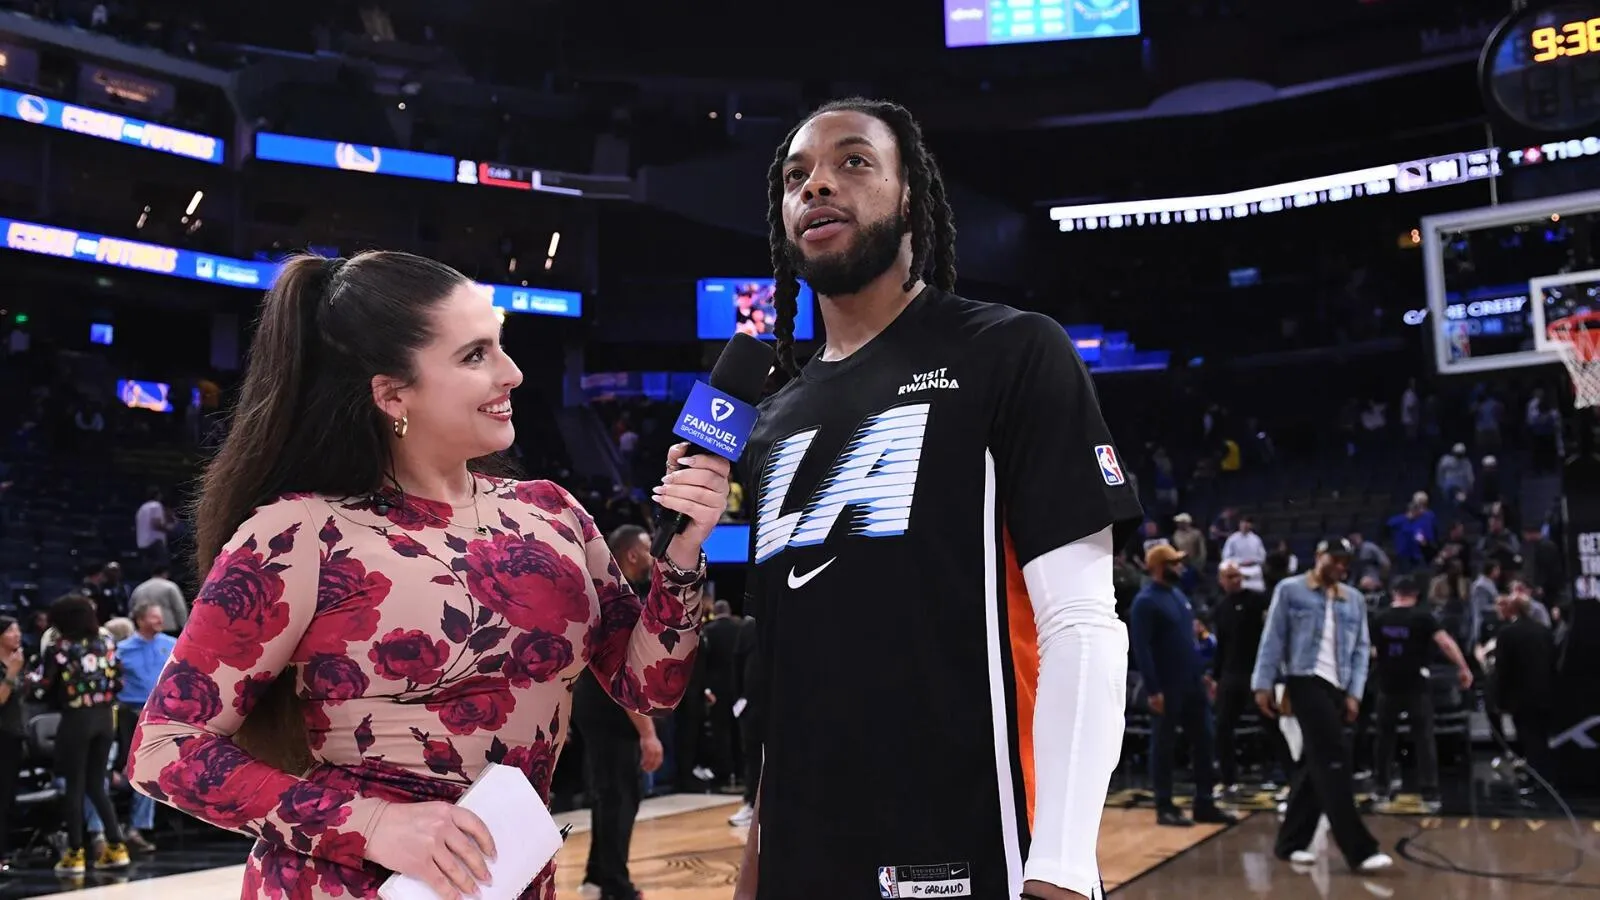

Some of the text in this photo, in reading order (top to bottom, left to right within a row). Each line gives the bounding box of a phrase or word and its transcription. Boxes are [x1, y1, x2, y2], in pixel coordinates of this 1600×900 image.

[898, 378, 960, 396] RWANDA
[913, 367, 948, 383] VISIT
[680, 424, 735, 454] SPORTS NETWORK
[683, 413, 737, 447] FANDUEL
[755, 403, 931, 565] LA
[924, 882, 964, 895] GARLAND
